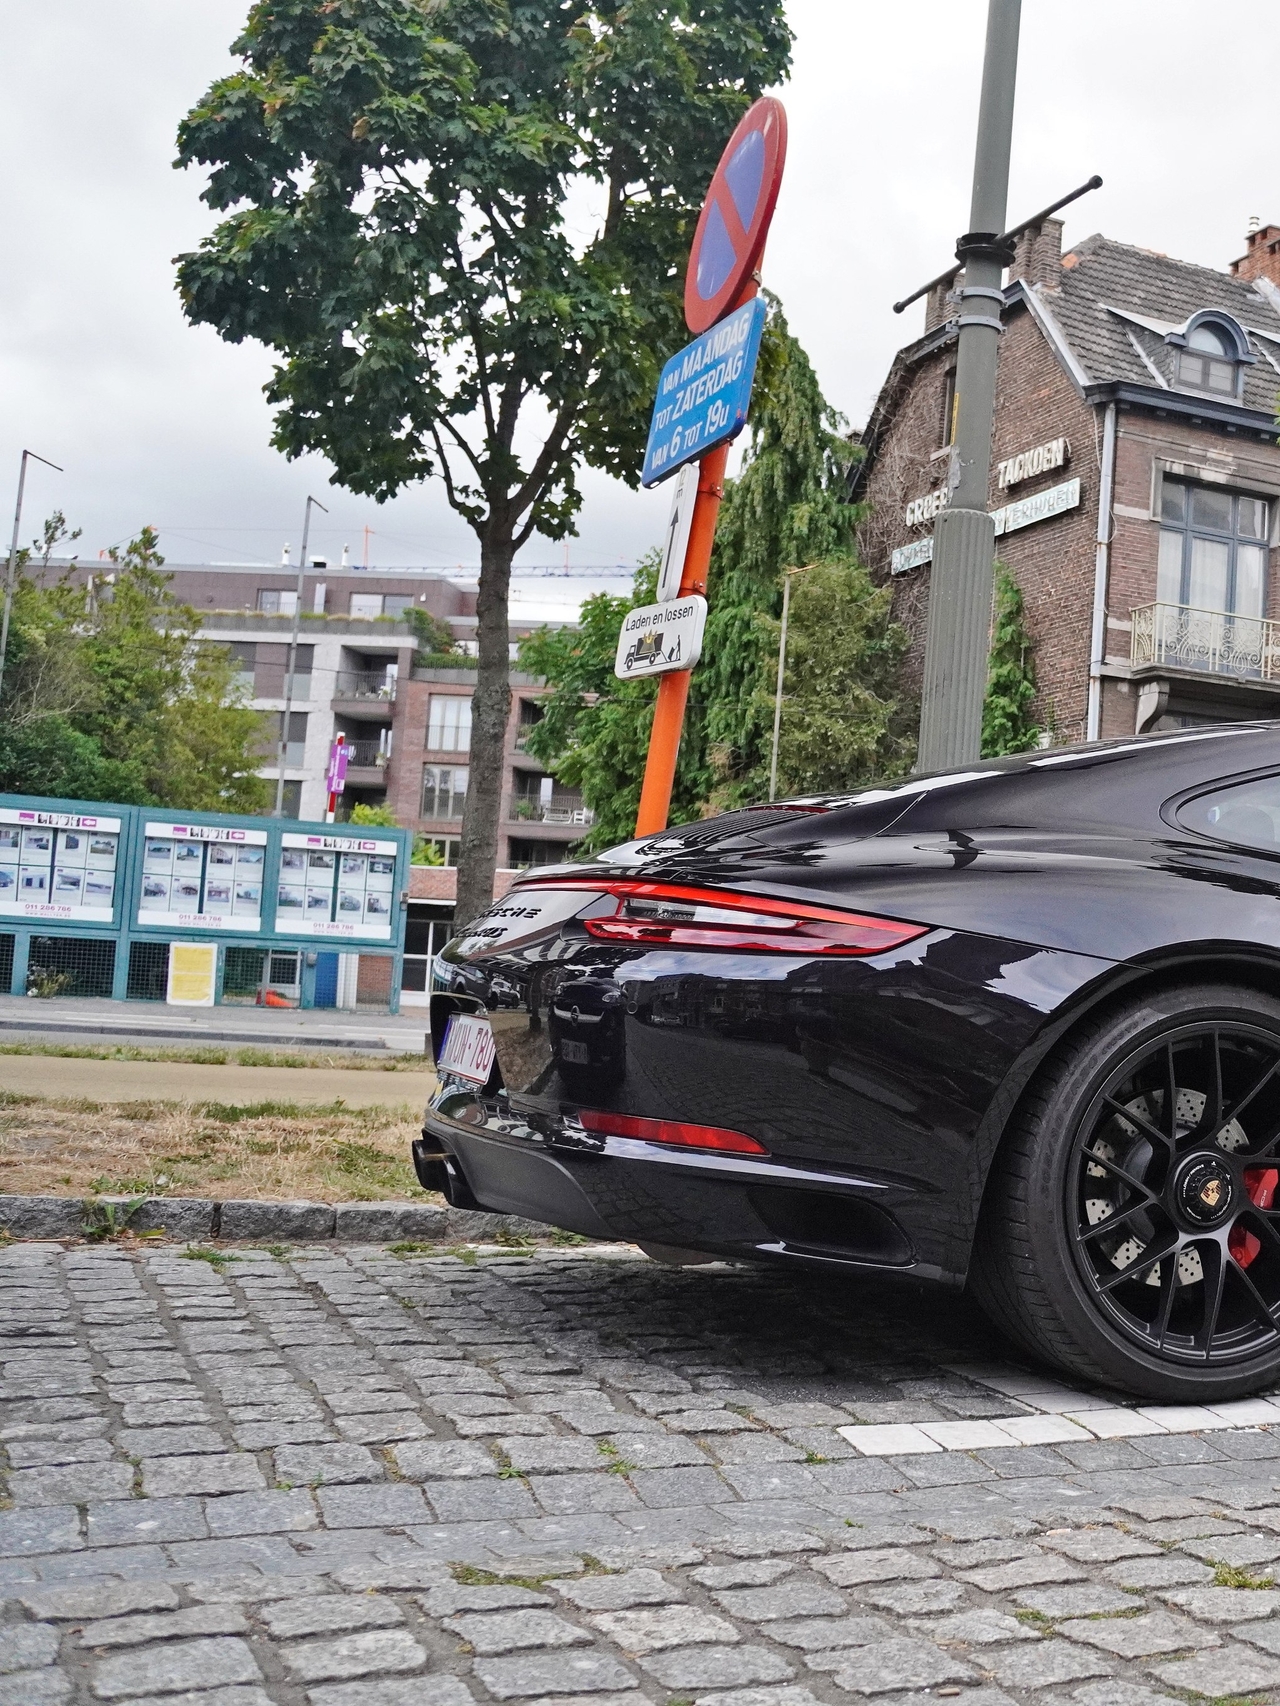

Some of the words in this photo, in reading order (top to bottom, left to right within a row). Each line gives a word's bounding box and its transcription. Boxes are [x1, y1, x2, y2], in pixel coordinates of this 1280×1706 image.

[663, 367, 681, 395] VAN
[681, 312, 750, 383] MAANDAG
[655, 405, 673, 432] TOT
[672, 350, 744, 421] ZATERDAG
[651, 442, 669, 470] VAN
[670, 425, 682, 458] 6
[683, 421, 703, 450] TOT
[998, 437, 1066, 489] TACKOEN
[625, 615, 650, 632] Laden
[652, 612, 663, 625] en
[665, 605, 694, 623] lossen
